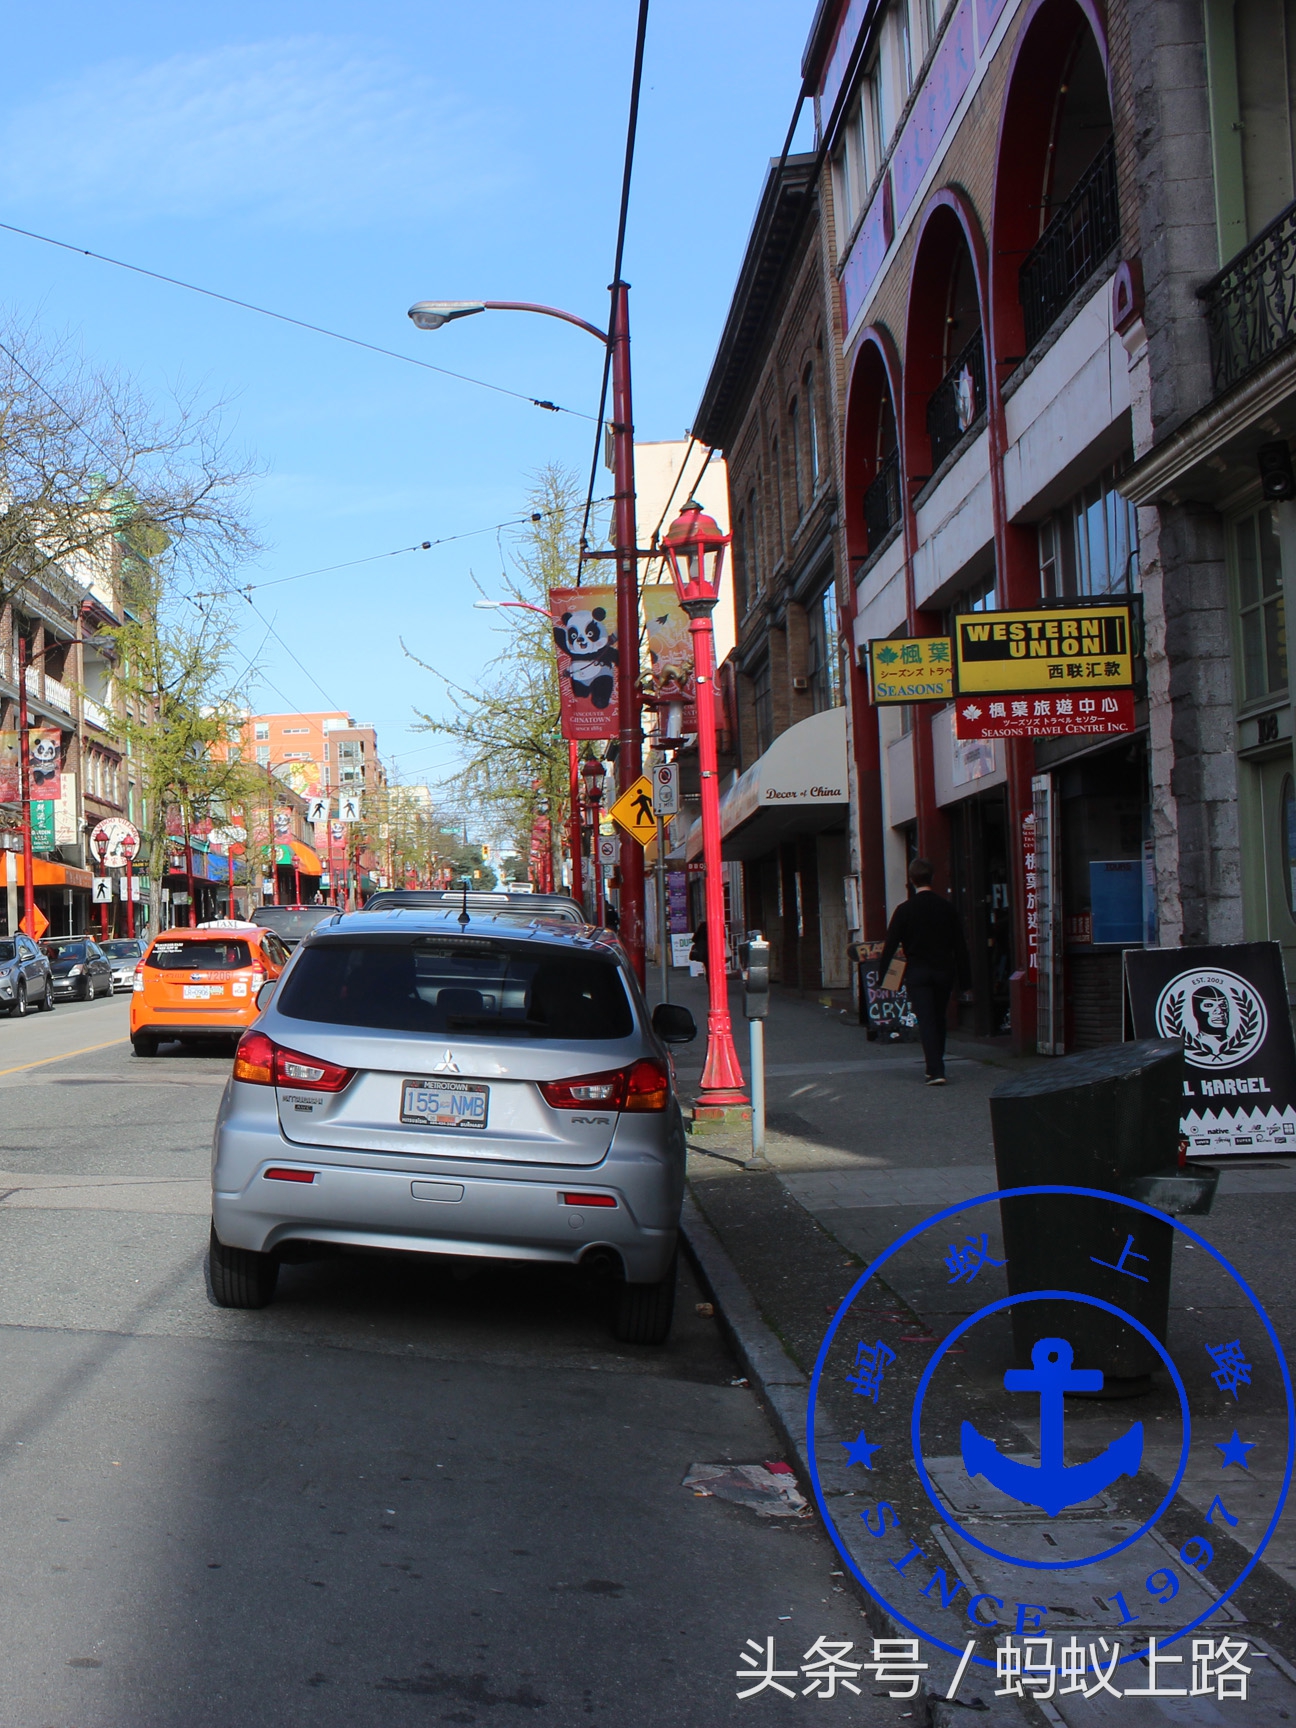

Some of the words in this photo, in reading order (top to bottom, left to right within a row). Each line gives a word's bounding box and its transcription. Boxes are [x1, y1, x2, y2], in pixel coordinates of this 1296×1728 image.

[966, 619, 1100, 642] WESTERN
[1009, 637, 1102, 658] UNION
[1048, 660, 1121, 680] 西联汇款
[877, 681, 944, 698] SEASONS
[988, 697, 1119, 719] 楓葉旅遊中心
[981, 726, 1024, 738] SEASONS
[1025, 725, 1063, 736] TRAVEL
[1065, 723, 1105, 734] CENTRE
[1107, 721, 1129, 732] INC.
[766, 788, 797, 799] Decor
[810, 786, 842, 797] China
[216, 919, 239, 928] TAXI
[1207, 976, 1224, 985] 2003
[424, 1081, 469, 1091] METROTOWN
[1182, 1080, 1196, 1097] L
[571, 1116, 610, 1125] RVR
[1207, 1128, 1230, 1136] native
